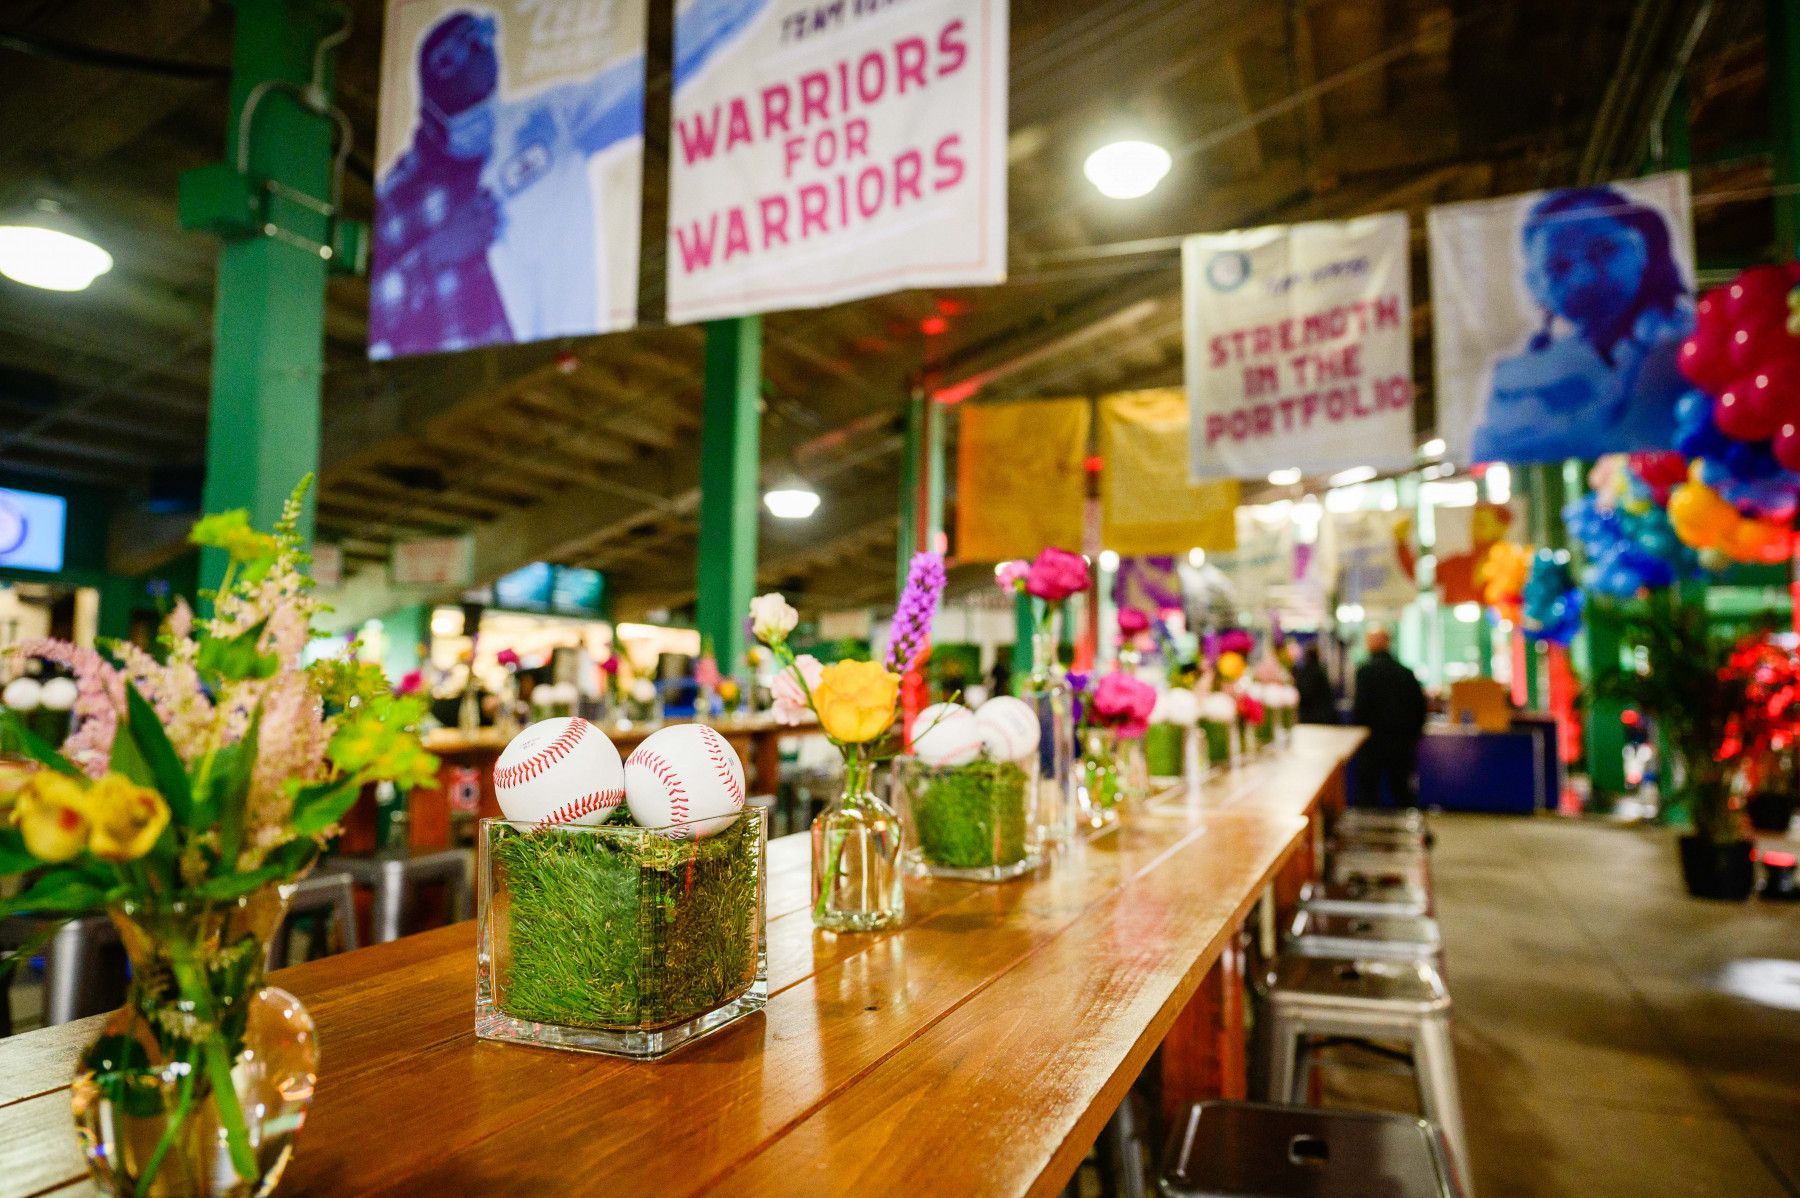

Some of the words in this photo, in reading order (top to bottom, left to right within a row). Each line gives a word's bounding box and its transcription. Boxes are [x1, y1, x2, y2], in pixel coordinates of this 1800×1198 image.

[675, 19, 969, 167] WARRIORS
[784, 118, 871, 180] FOR
[674, 133, 967, 276] WARRIORS
[1209, 295, 1400, 369] STRENGTH
[1243, 364, 1278, 400] IN
[1291, 343, 1362, 388] THE
[1206, 374, 1414, 449] PORTFOLIO
